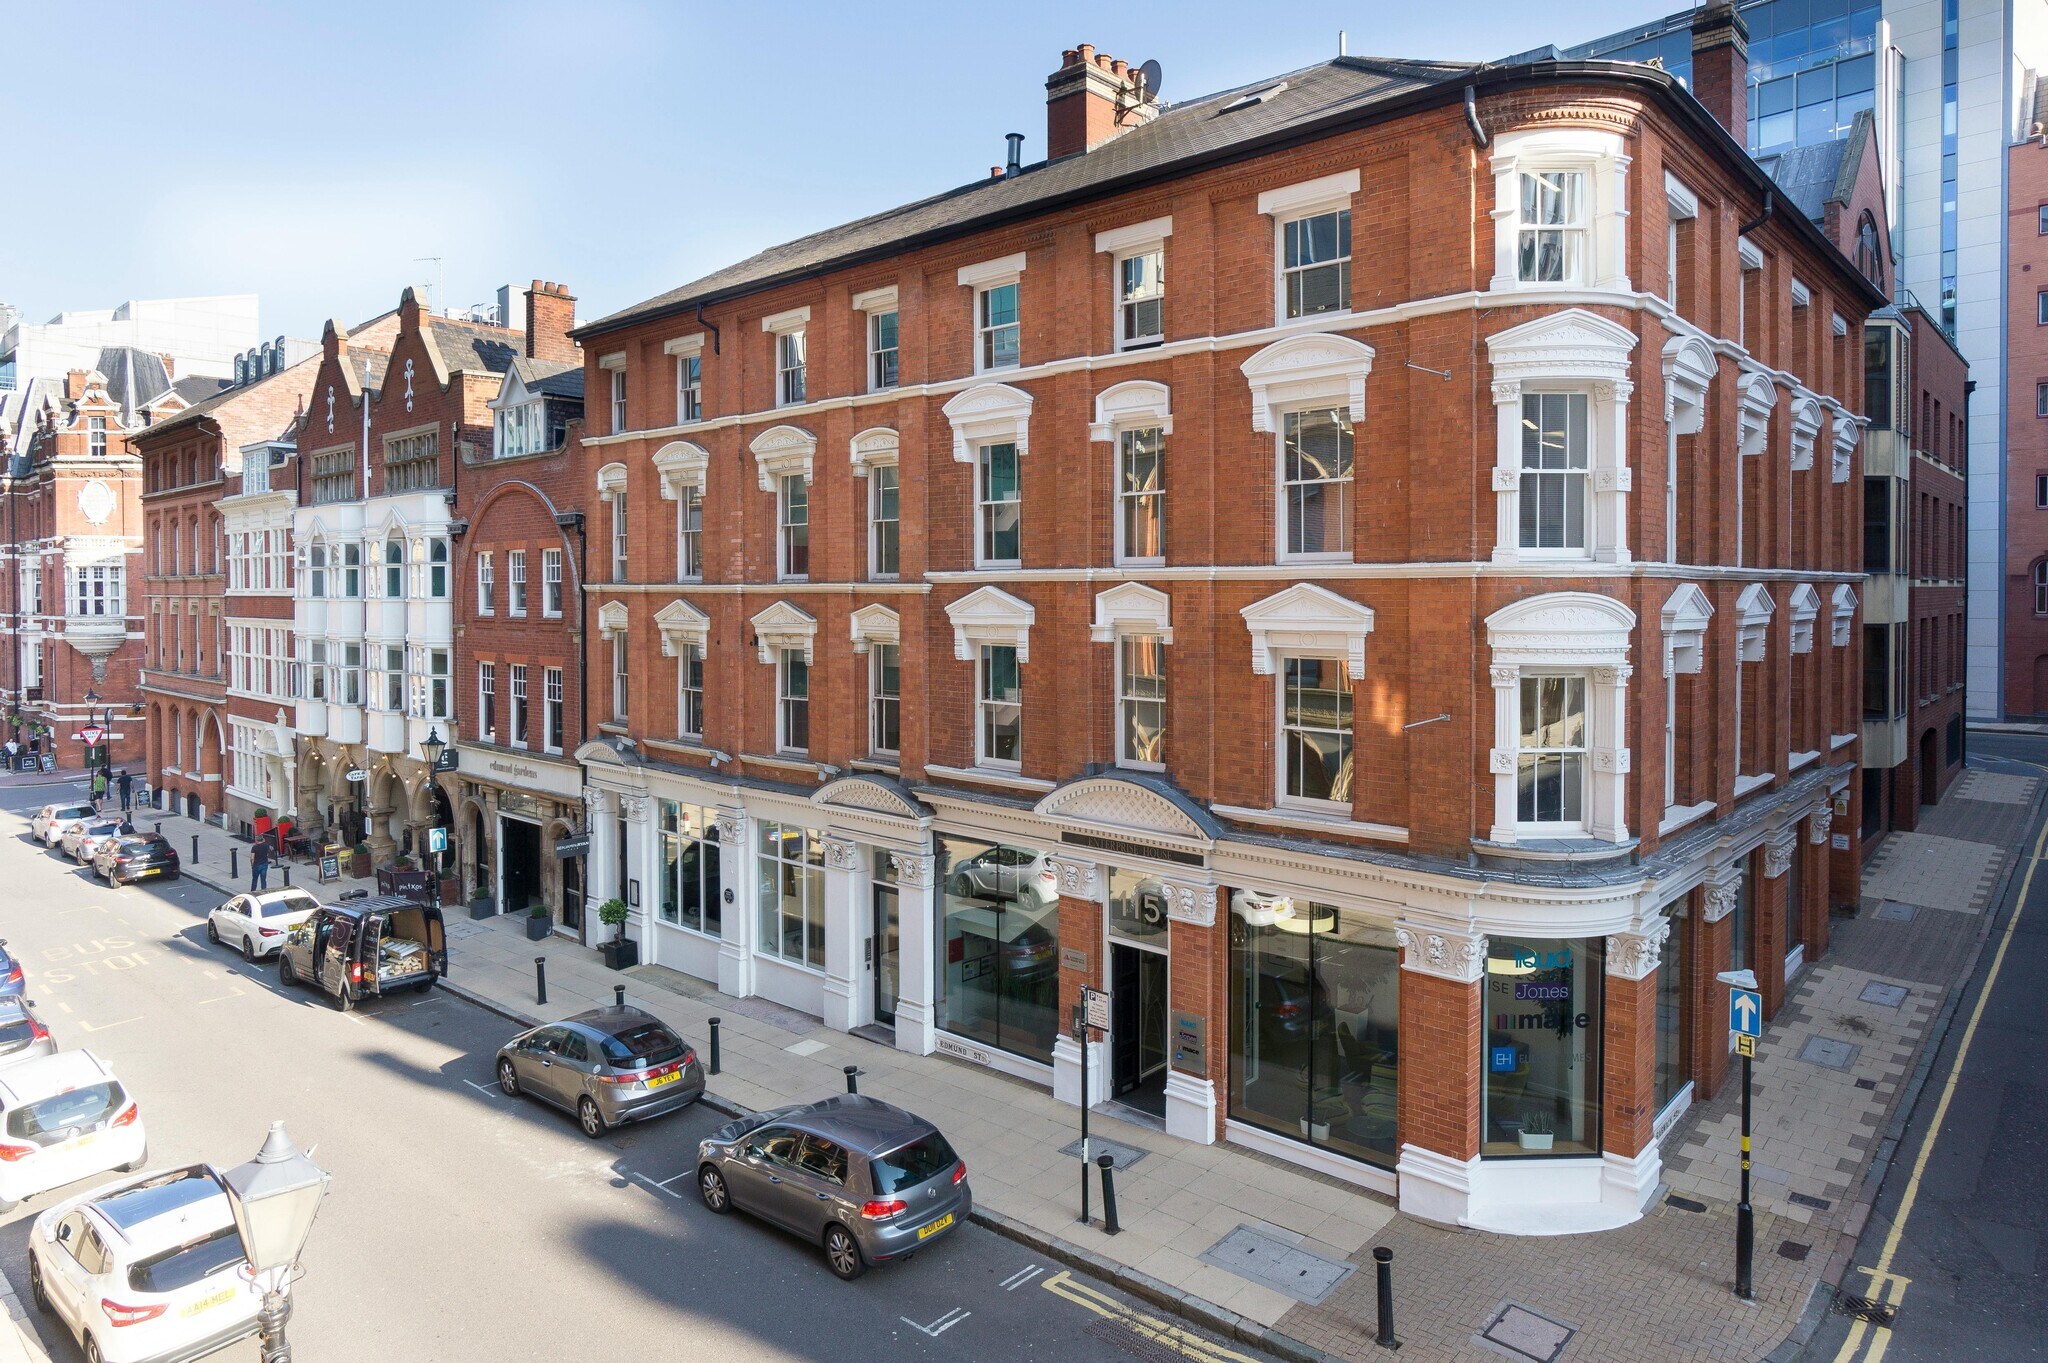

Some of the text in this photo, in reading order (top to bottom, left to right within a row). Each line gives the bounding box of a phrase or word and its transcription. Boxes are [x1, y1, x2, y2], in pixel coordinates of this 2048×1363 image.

[1088, 836, 1172, 860] ENTERPRISE HOUSE
[1118, 890, 1160, 923] 115
[41, 936, 136, 961] BUS
[1515, 945, 1571, 968] liquid
[43, 950, 162, 983] STOP
[1515, 983, 1569, 999] Jones
[1518, 1013, 1592, 1029] mae
[940, 1040, 967, 1055] EDMUND
[1738, 1036, 1752, 1055] H
